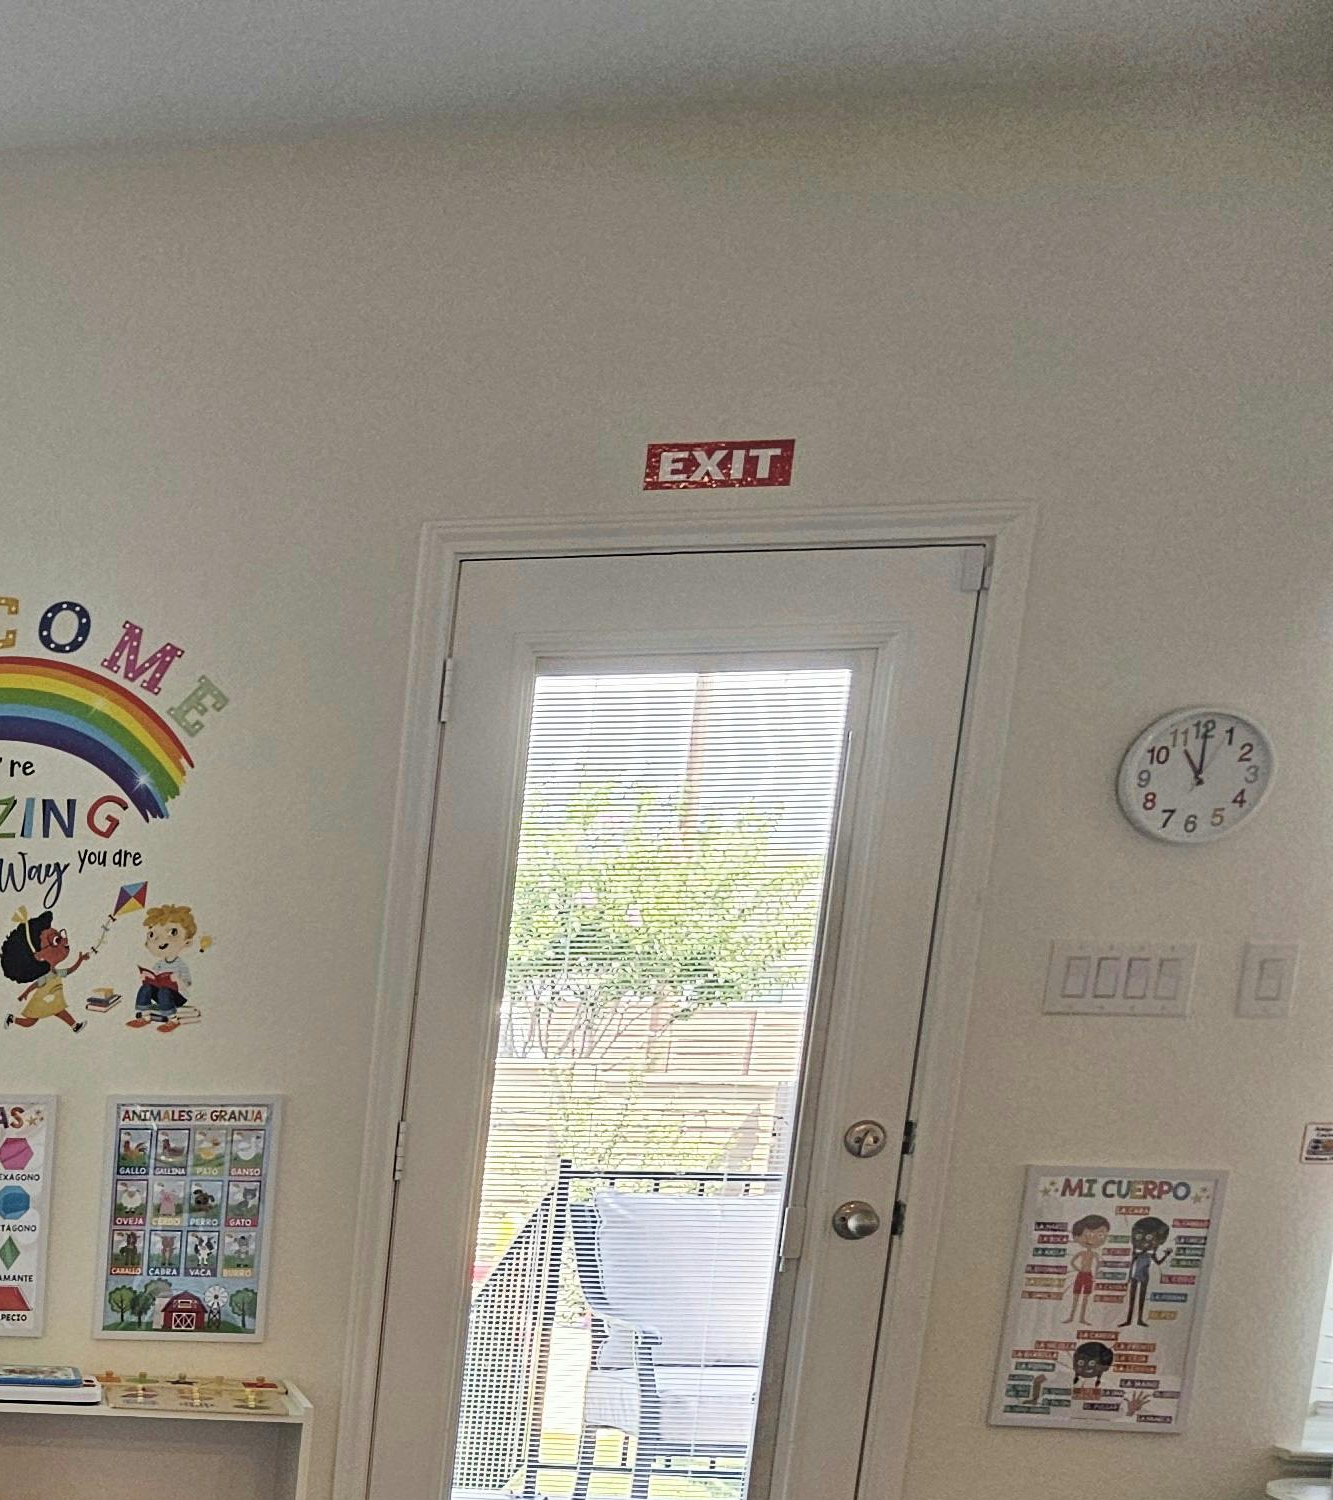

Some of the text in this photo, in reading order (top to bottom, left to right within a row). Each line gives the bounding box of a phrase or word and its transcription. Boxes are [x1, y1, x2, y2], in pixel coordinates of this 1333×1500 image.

[658, 448, 782, 482] EXIT
[1170, 728, 1189, 747] 11
[1192, 719, 1216, 739] 12
[1225, 726, 1236, 746] 1
[1147, 746, 1169, 765] 10
[1238, 743, 1254, 762] 2
[1137, 770, 1151, 788] 9
[1245, 765, 1259, 784] 3
[1142, 792, 1157, 810] 8
[1231, 788, 1247, 808] 4
[1161, 809, 1176, 829] 7
[1184, 814, 1197, 833] 6
[1210, 808, 1225, 827] 5
[77, 849, 109, 869] you
[112, 849, 143, 868] are
[122, 1109, 193, 1122] ANIMALES
[210, 1110, 263, 1122] GRANJA
[119, 1167, 146, 1175] GALLO
[230, 1168, 261, 1176] GANSO
[1061, 1178, 1191, 1201] MI CUERPO
[116, 1217, 144, 1225] OVEJA
[149, 1268, 177, 1276] CABRA
